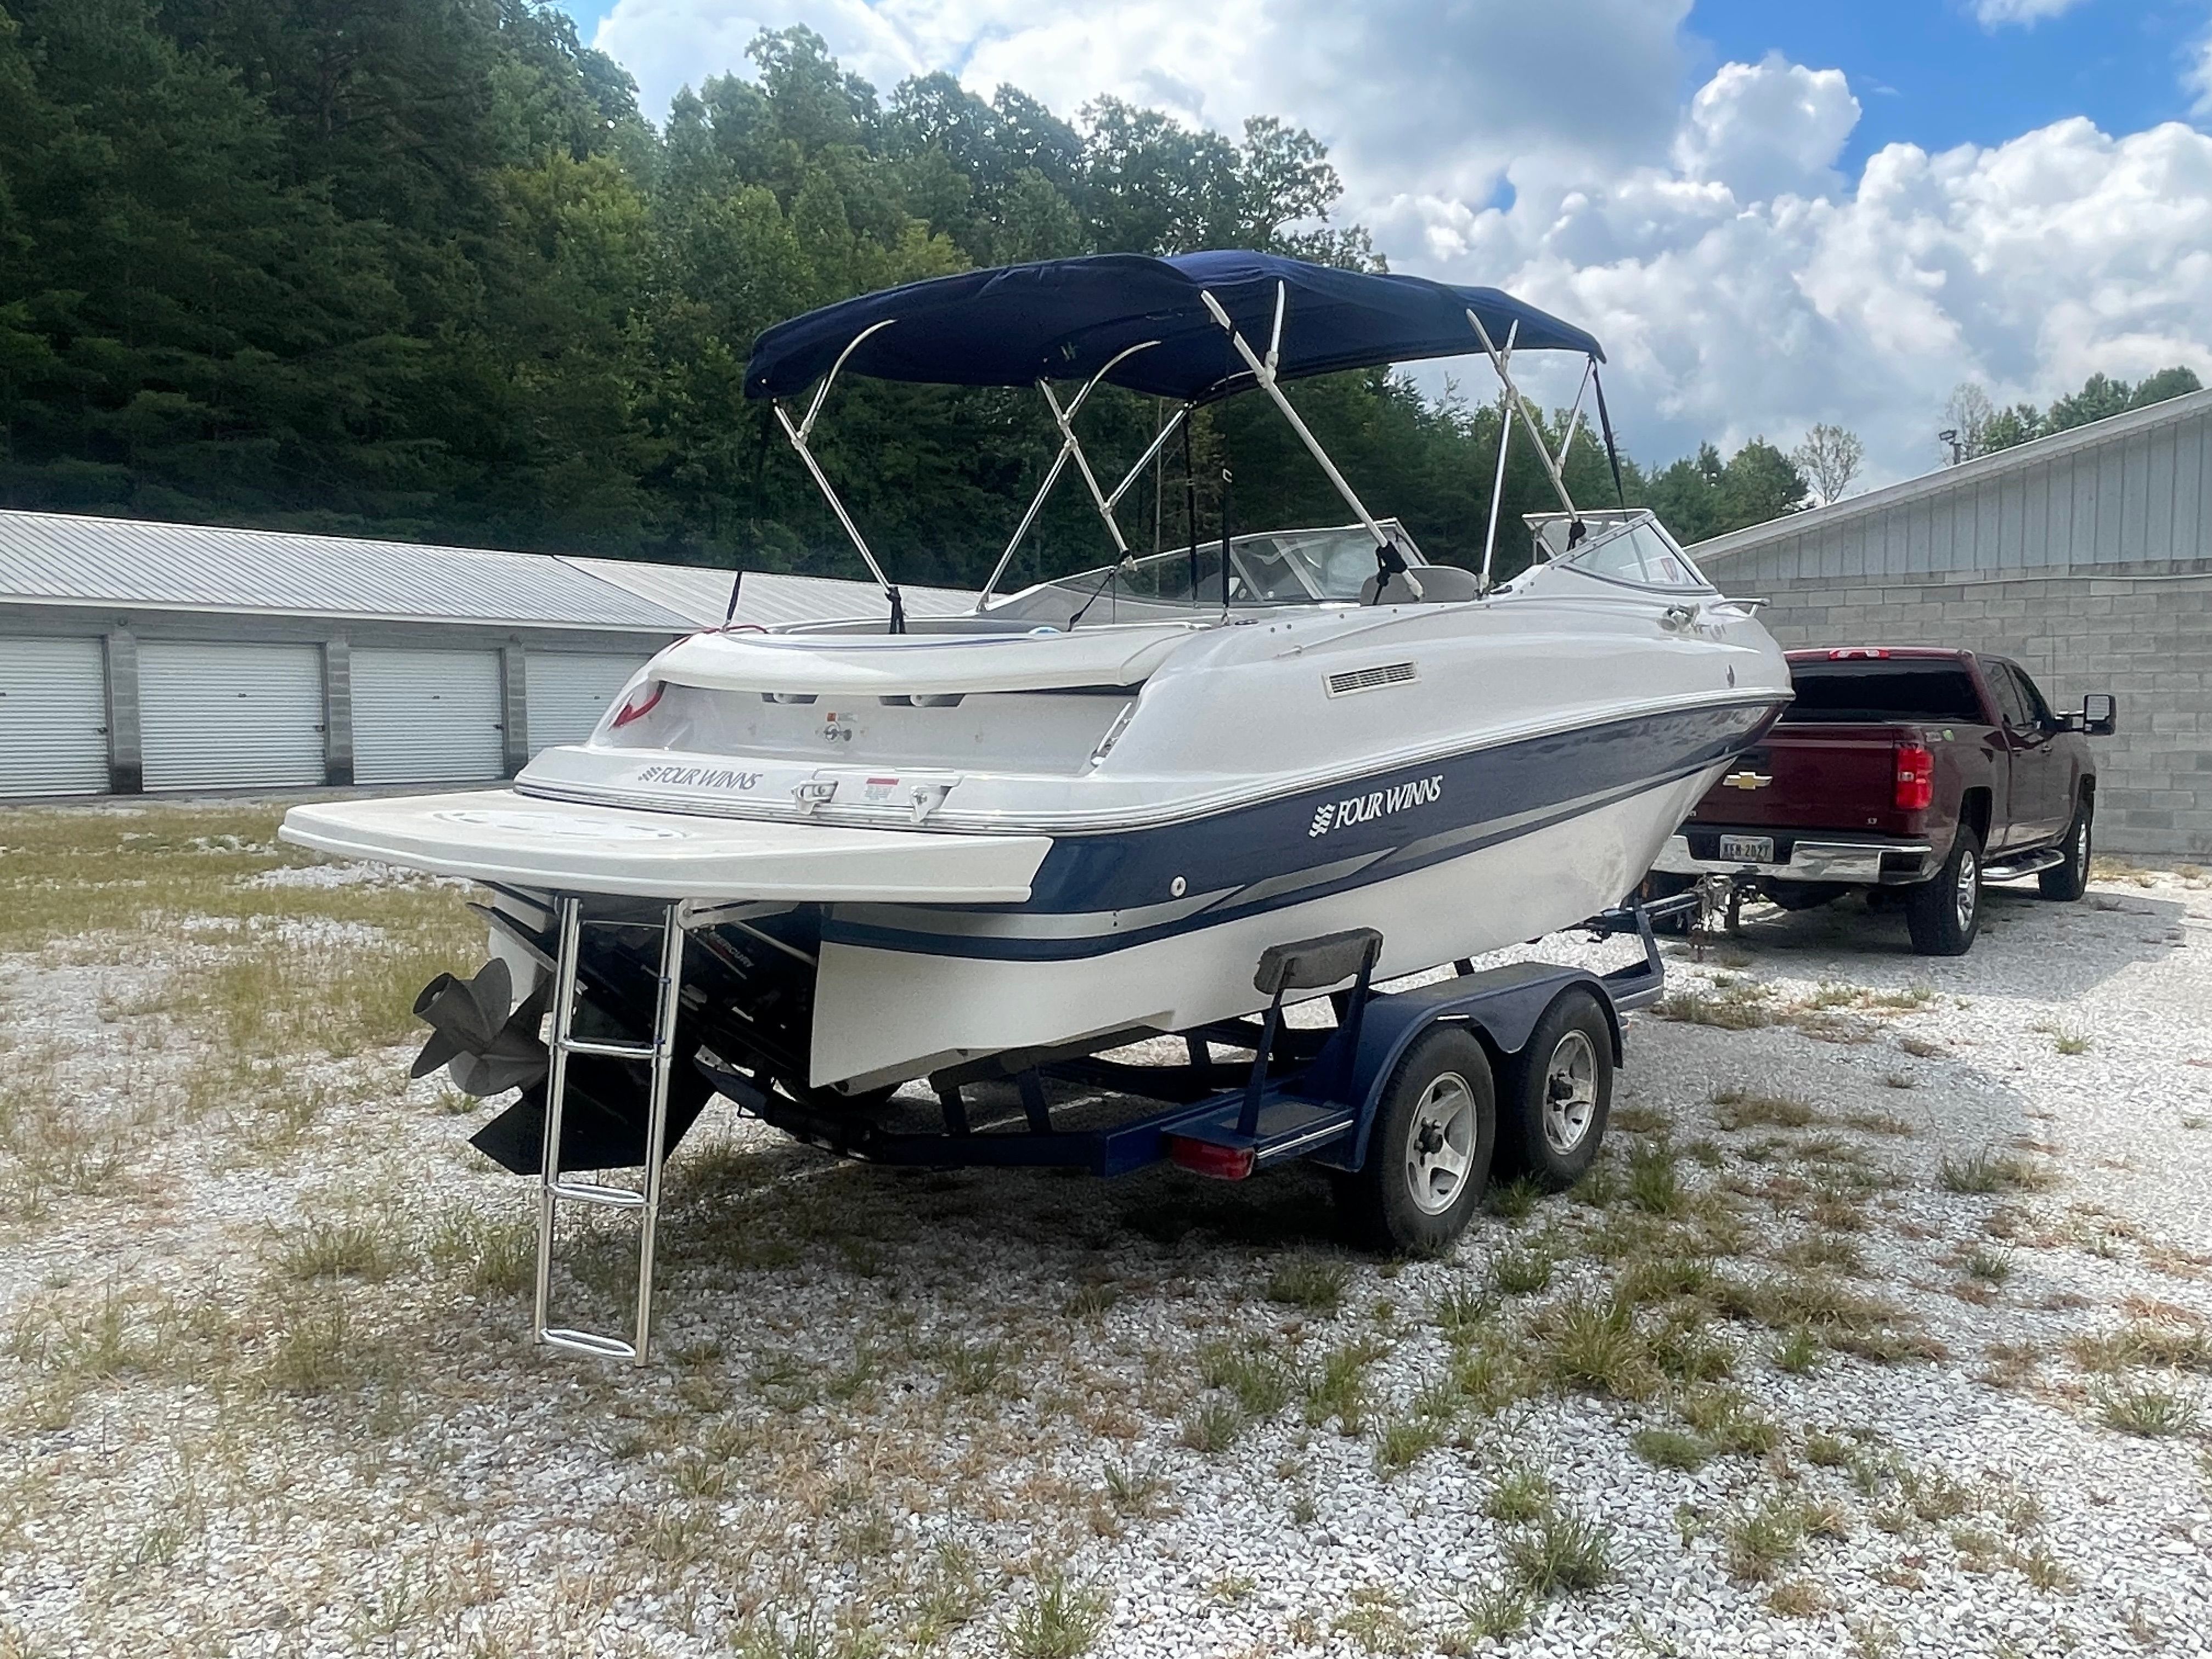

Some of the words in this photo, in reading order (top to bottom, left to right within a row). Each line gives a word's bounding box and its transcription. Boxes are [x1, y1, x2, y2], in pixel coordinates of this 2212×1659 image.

[654, 767, 701, 785] FOUR
[698, 770, 763, 789] WINNS
[1334, 792, 1384, 830] FOUR
[1385, 775, 1443, 814] WINNS
